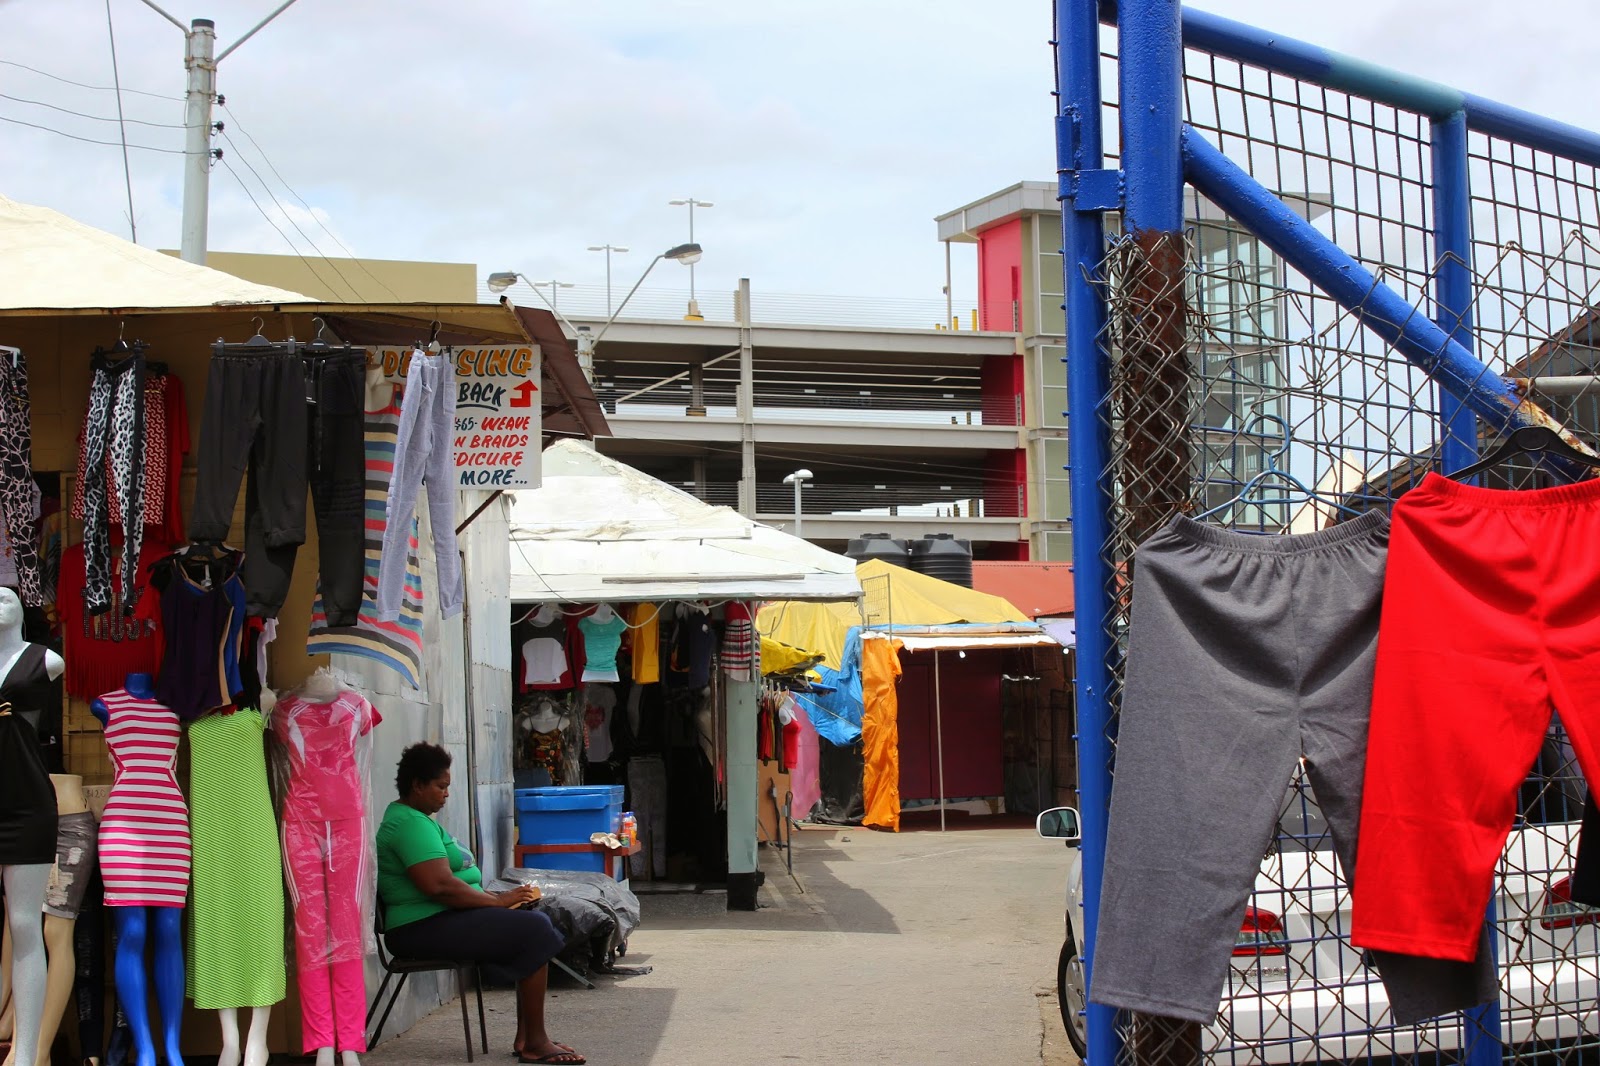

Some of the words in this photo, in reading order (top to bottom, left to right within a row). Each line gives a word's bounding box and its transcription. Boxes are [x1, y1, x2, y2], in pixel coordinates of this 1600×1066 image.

[381, 347, 532, 378] DSING
[457, 382, 507, 407] BACK
[481, 416, 531, 431] WEAVE
[469, 434, 529, 449] BRAIDS
[453, 451, 524, 467] DICURE
[460, 469, 528, 486] MORE...
